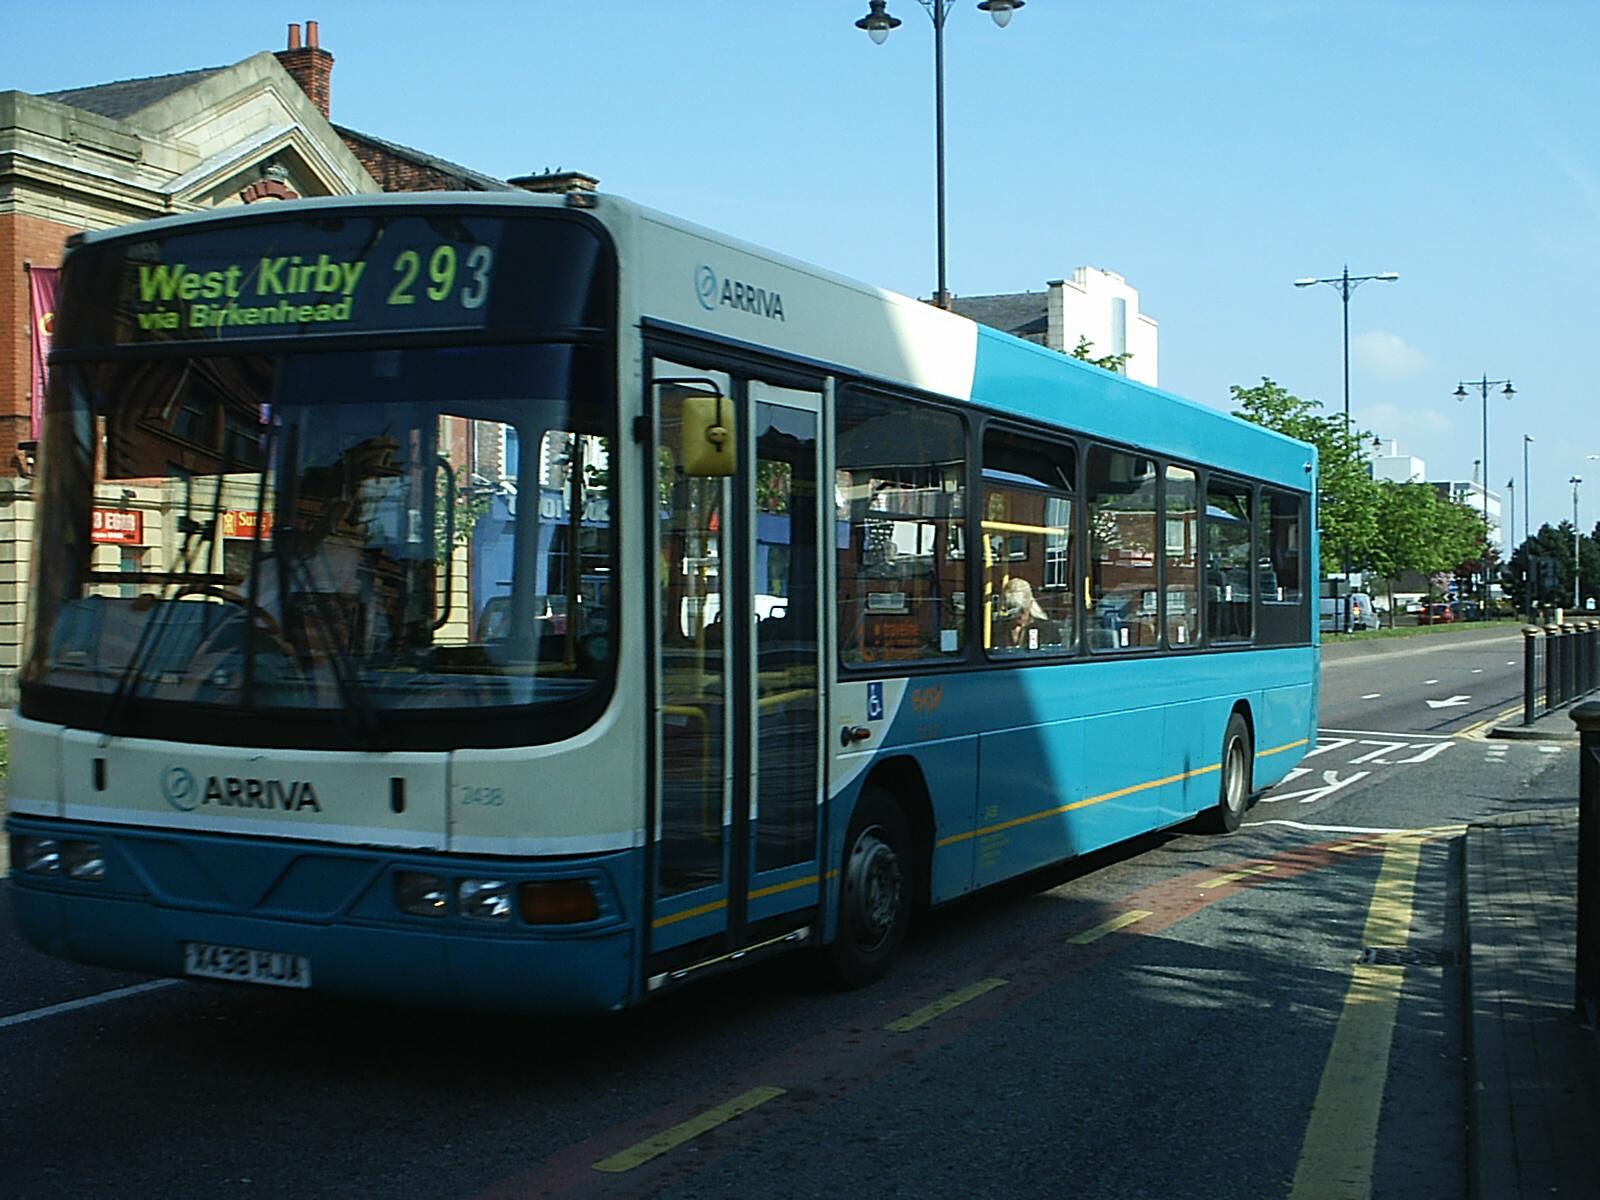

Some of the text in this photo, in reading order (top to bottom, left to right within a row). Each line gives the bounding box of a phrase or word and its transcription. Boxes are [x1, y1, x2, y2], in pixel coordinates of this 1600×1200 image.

[139, 254, 366, 302] West Kirby
[387, 245, 494, 310] 293
[138, 296, 353, 330] via Birkenhead
[719, 278, 785, 322] ARRIVA
[202, 775, 322, 813] ARRIVA
